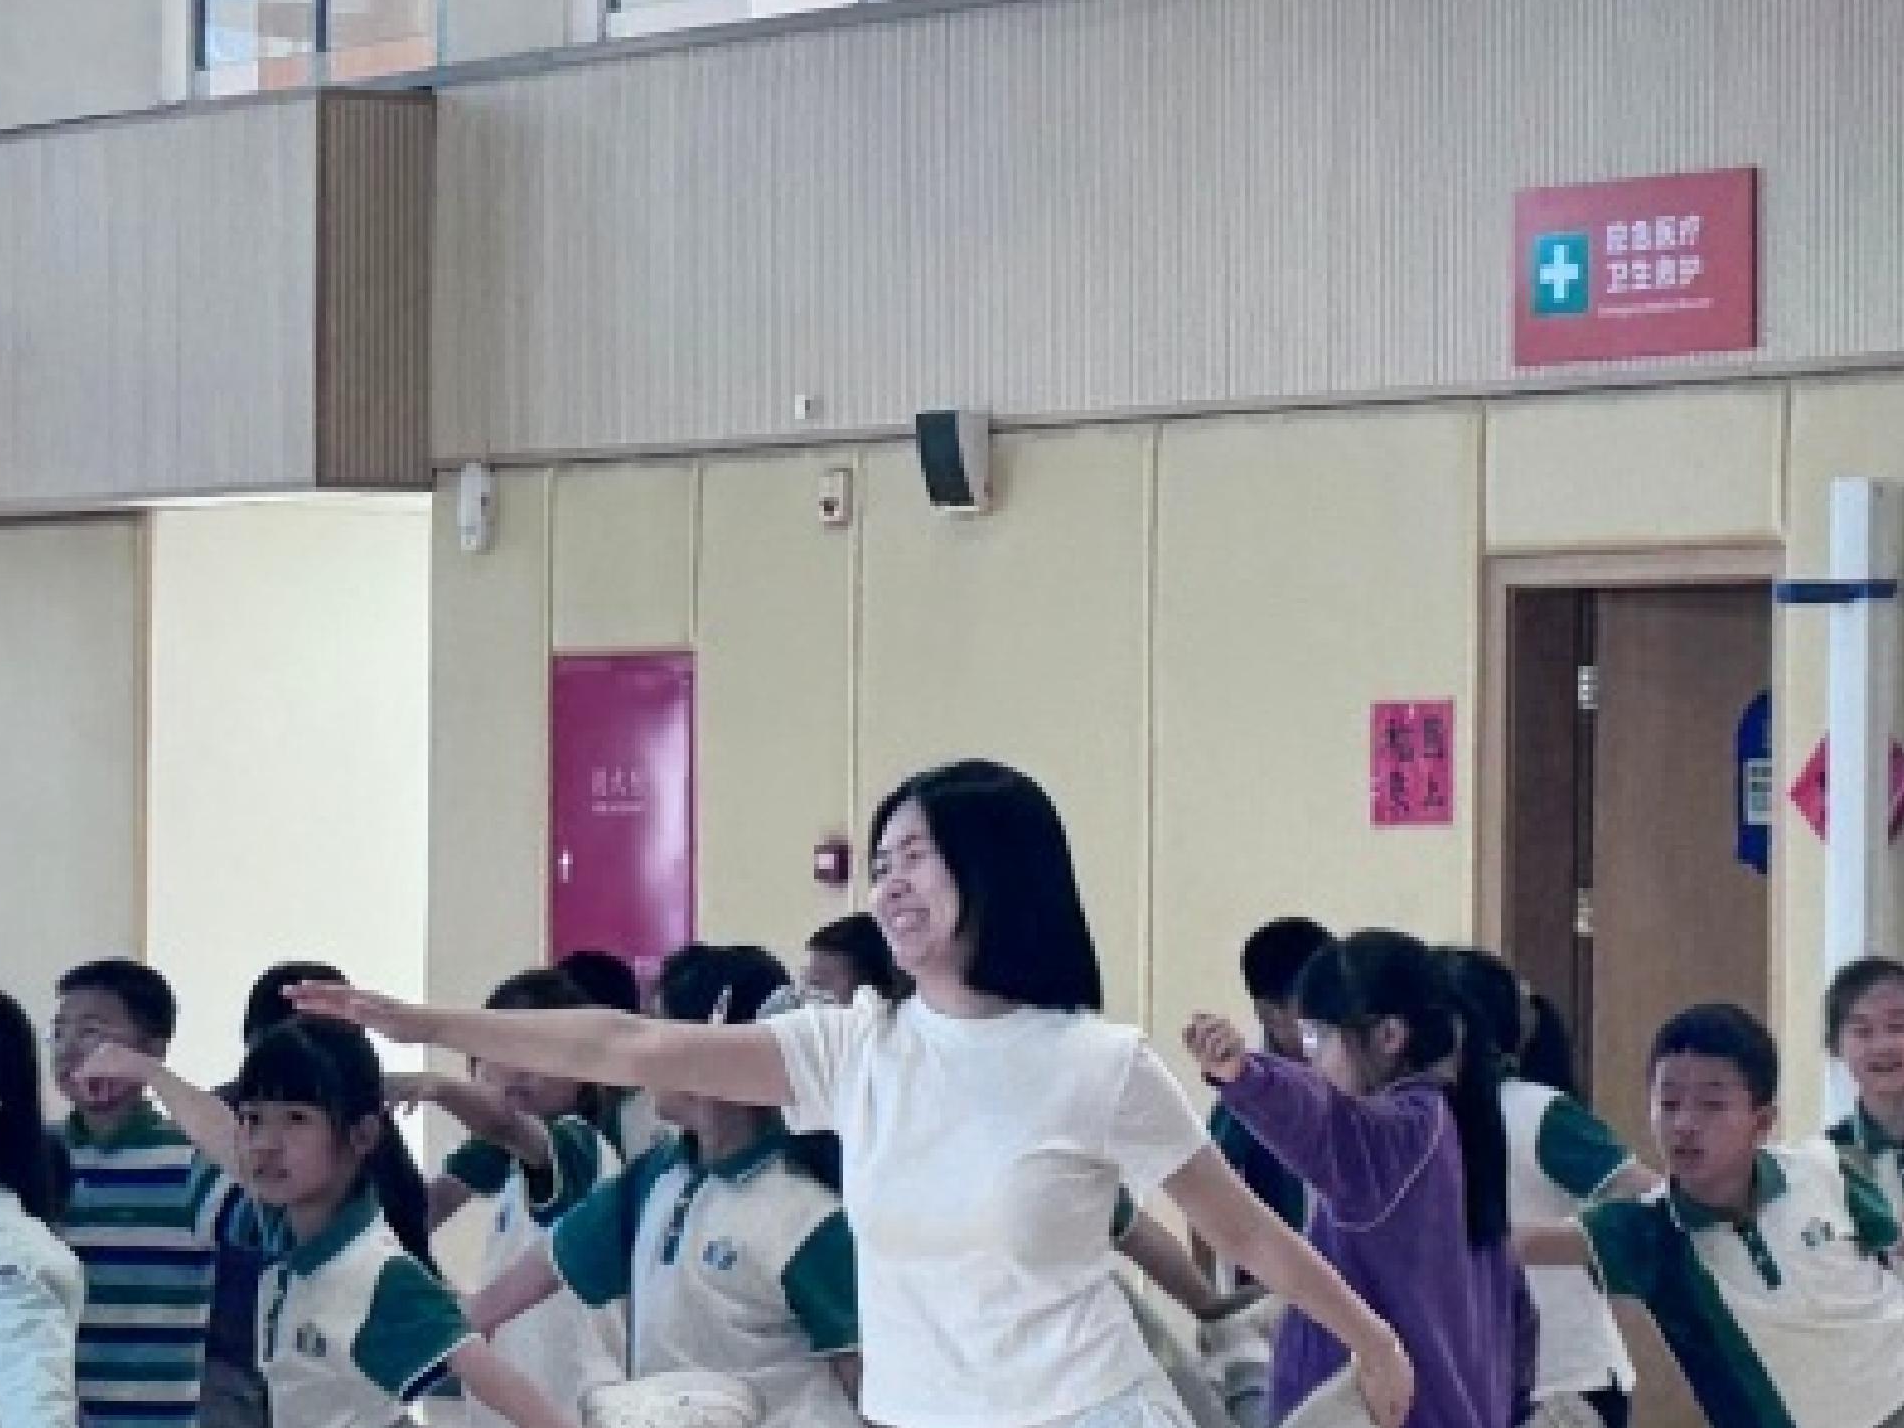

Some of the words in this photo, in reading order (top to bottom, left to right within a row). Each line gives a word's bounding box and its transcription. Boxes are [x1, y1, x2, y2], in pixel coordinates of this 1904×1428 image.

[1606, 214, 1702, 256] 应急医疗
[1606, 254, 1704, 294] 卫生救护
